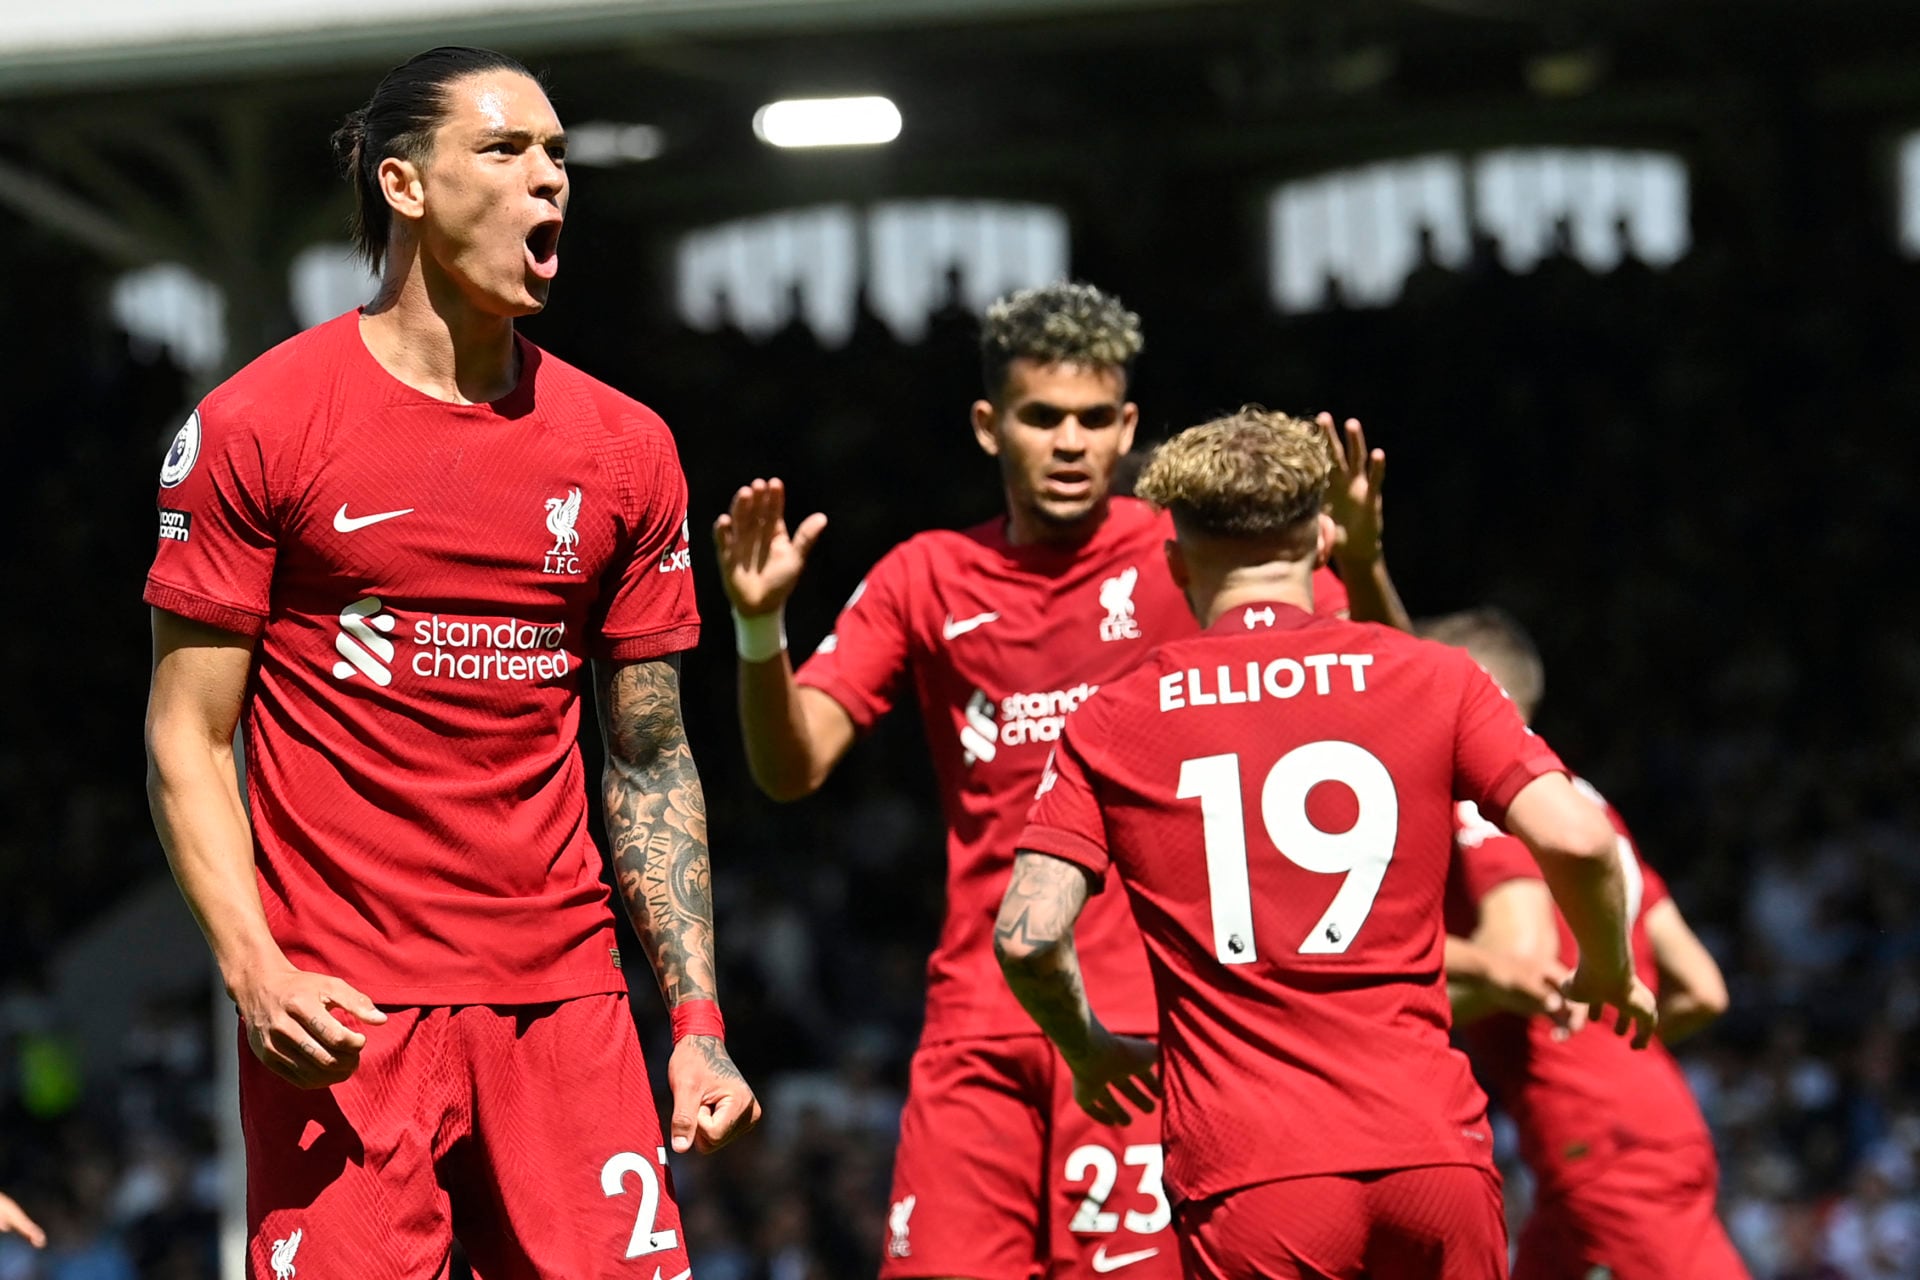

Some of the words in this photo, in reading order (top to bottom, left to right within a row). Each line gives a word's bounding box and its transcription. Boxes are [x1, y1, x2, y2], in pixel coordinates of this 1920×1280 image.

[412, 647, 569, 681] chartered
[413, 614, 565, 649] standard
[1159, 653, 1374, 713] ELLIOTT
[1175, 740, 1399, 965] 19
[600, 1146, 679, 1260] 2
[1064, 1143, 1172, 1234] 23
